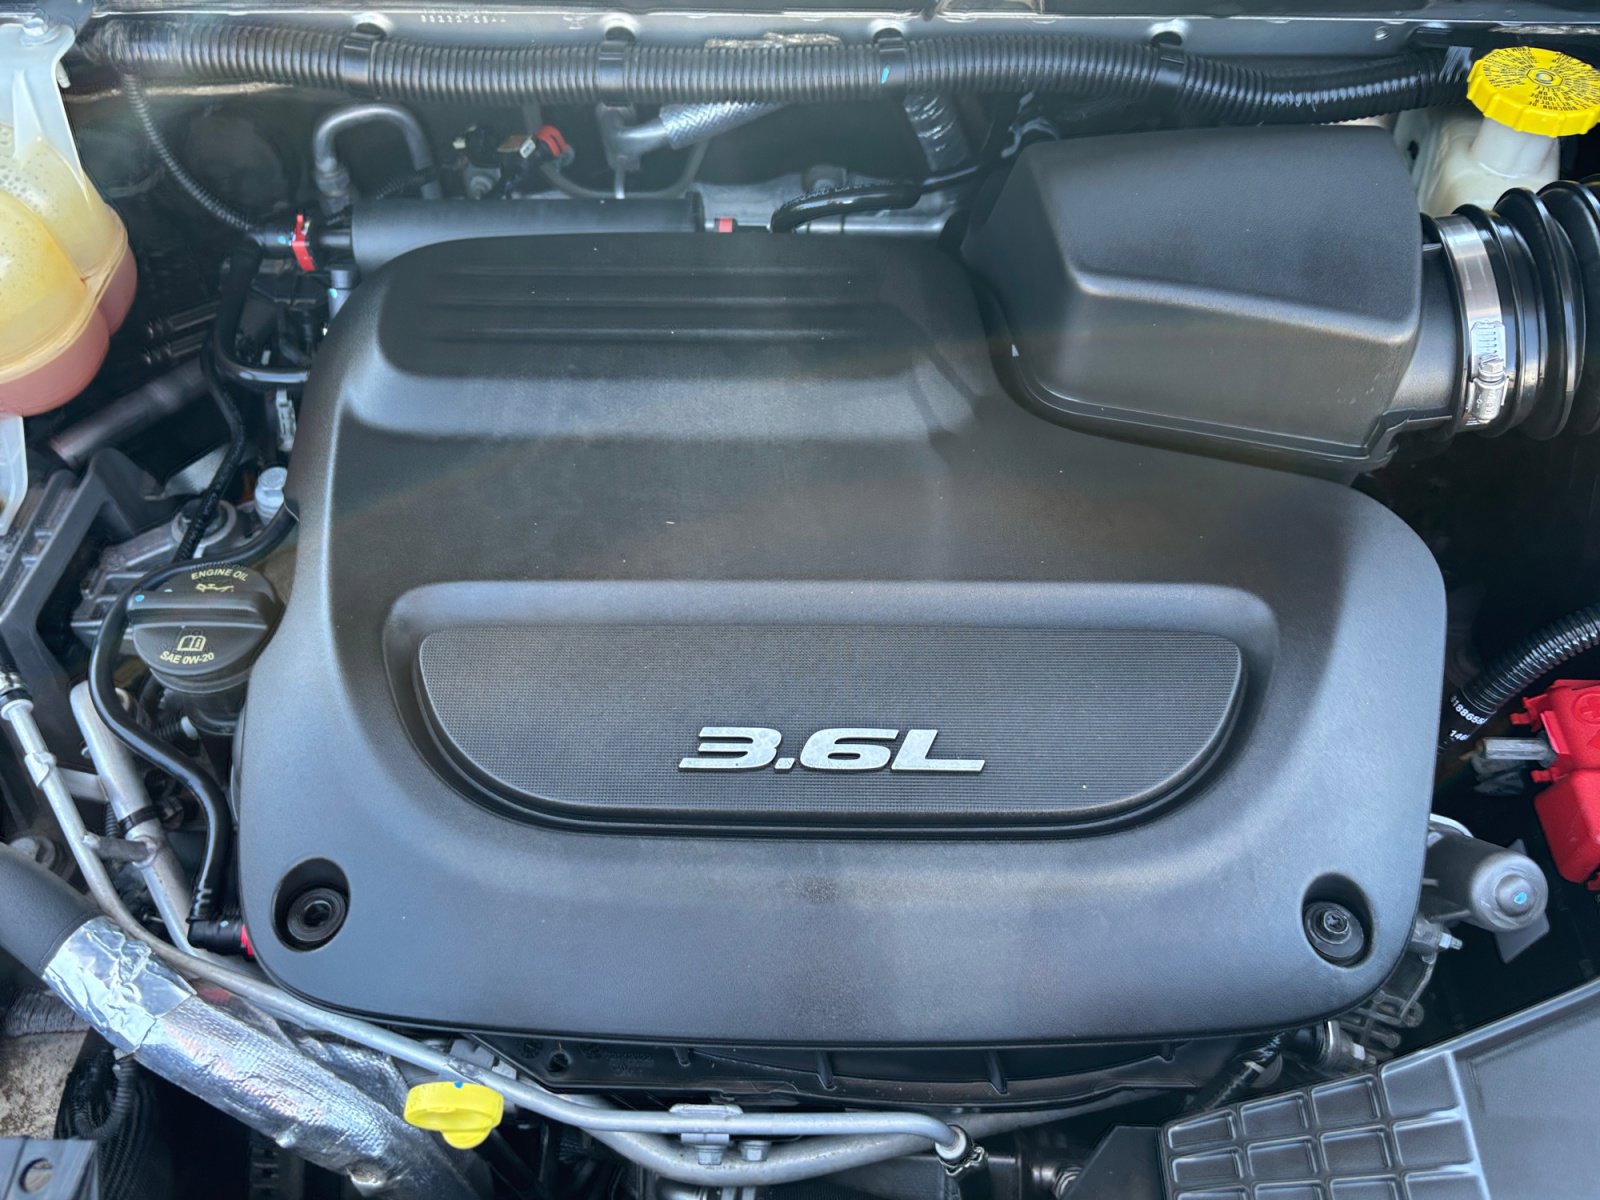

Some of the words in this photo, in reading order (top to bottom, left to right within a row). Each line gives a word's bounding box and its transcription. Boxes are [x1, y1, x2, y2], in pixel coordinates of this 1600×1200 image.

[191, 568, 233, 580] ENGINE
[233, 570, 249, 581] OIL
[160, 650, 181, 664] SAE
[182, 652, 214, 664] 0W-20
[678, 726, 986, 772] 3.6L
